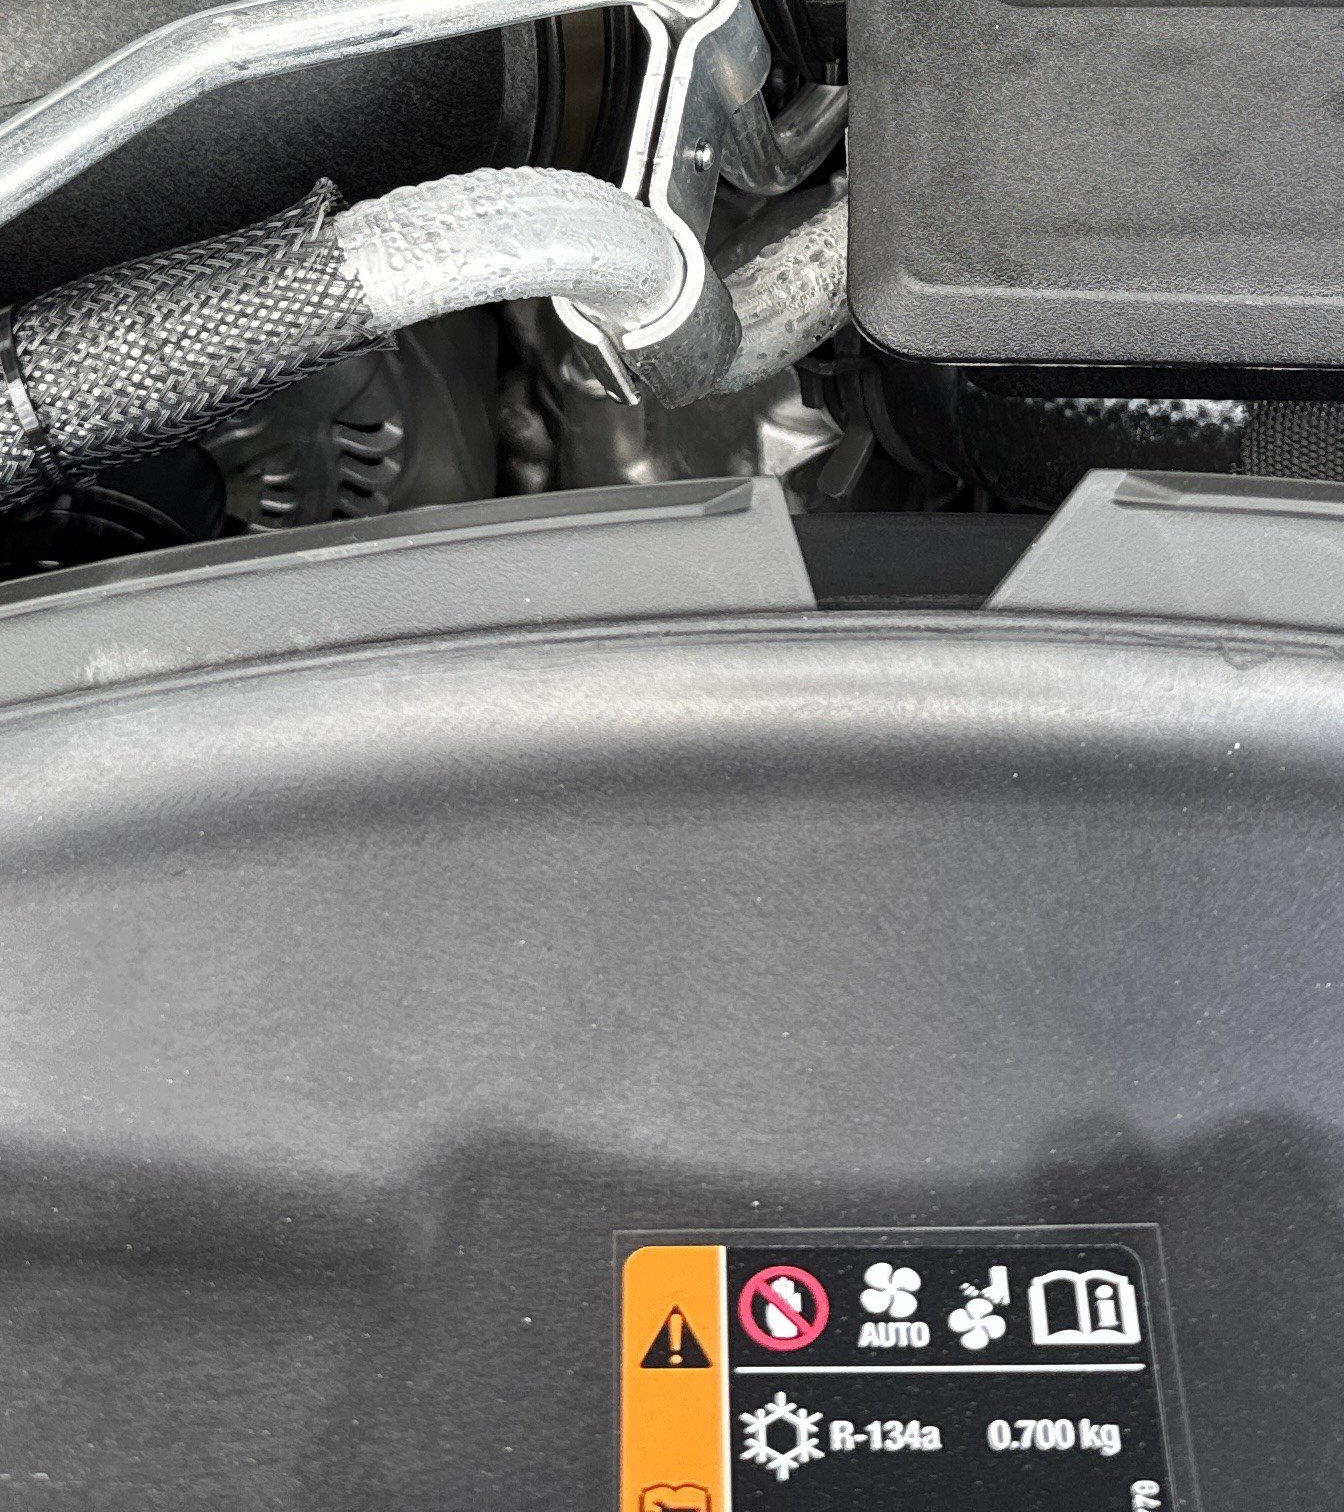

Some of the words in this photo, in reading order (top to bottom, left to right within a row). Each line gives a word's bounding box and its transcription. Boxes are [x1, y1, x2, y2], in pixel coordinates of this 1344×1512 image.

[858, 1321, 931, 1348] AUTO
[829, 1420, 943, 1452] R-134a
[987, 1418, 1075, 1451] 0.700
[1078, 1418, 1122, 1457] kg
